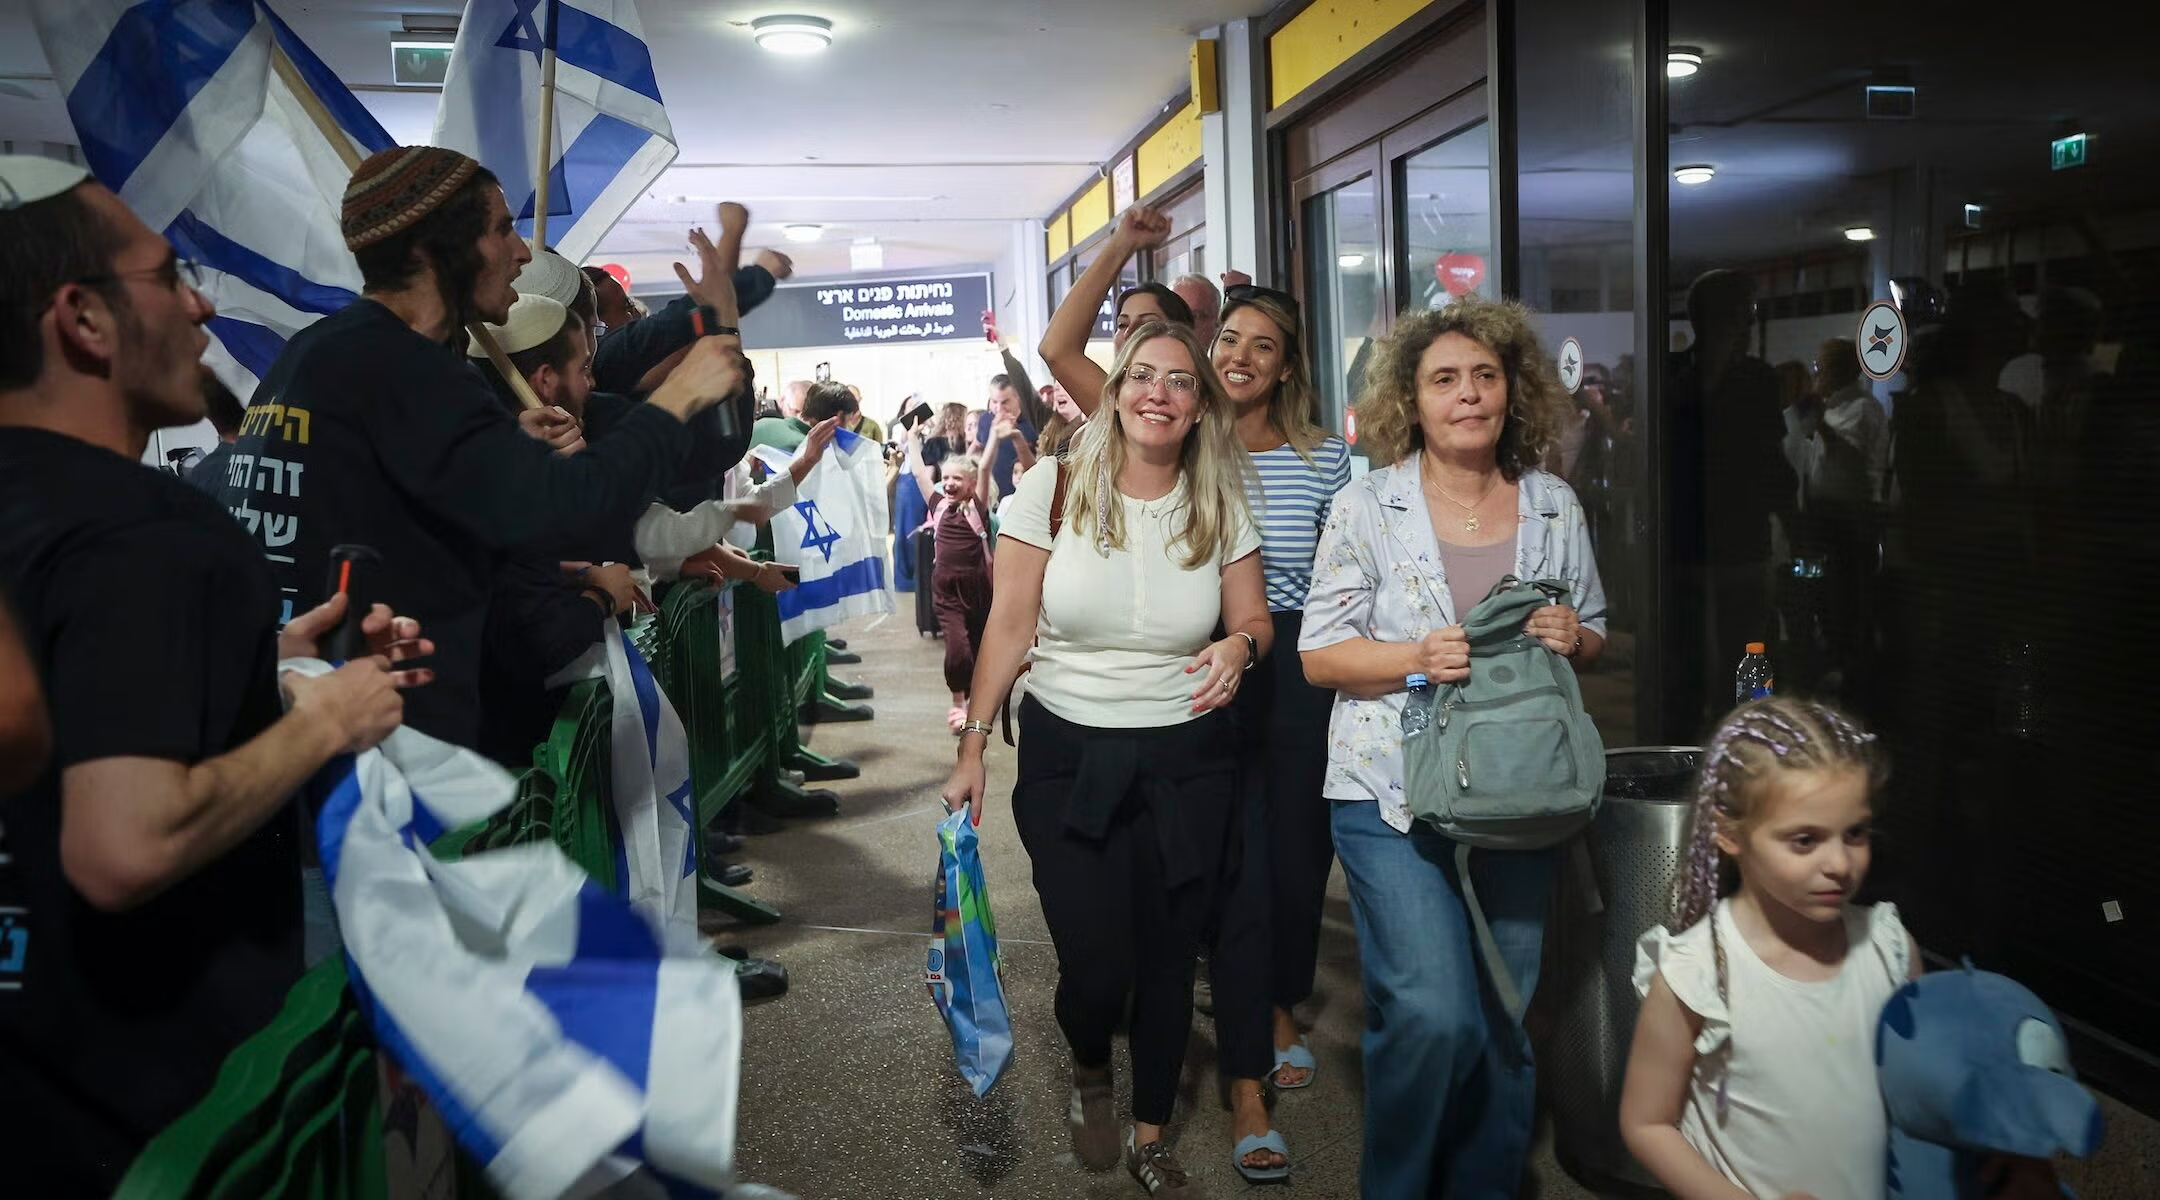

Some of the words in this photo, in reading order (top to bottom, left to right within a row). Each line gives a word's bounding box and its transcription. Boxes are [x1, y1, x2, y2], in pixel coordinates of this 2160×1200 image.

[817, 288, 855, 305] ארצי
[857, 286, 893, 303] פנים
[897, 282, 953, 301] נחיתות
[842, 303, 904, 322] Domestic
[904, 300, 955, 319] Arrivals
[238, 396, 311, 445] הילדים
[255, 456, 304, 497] זה
